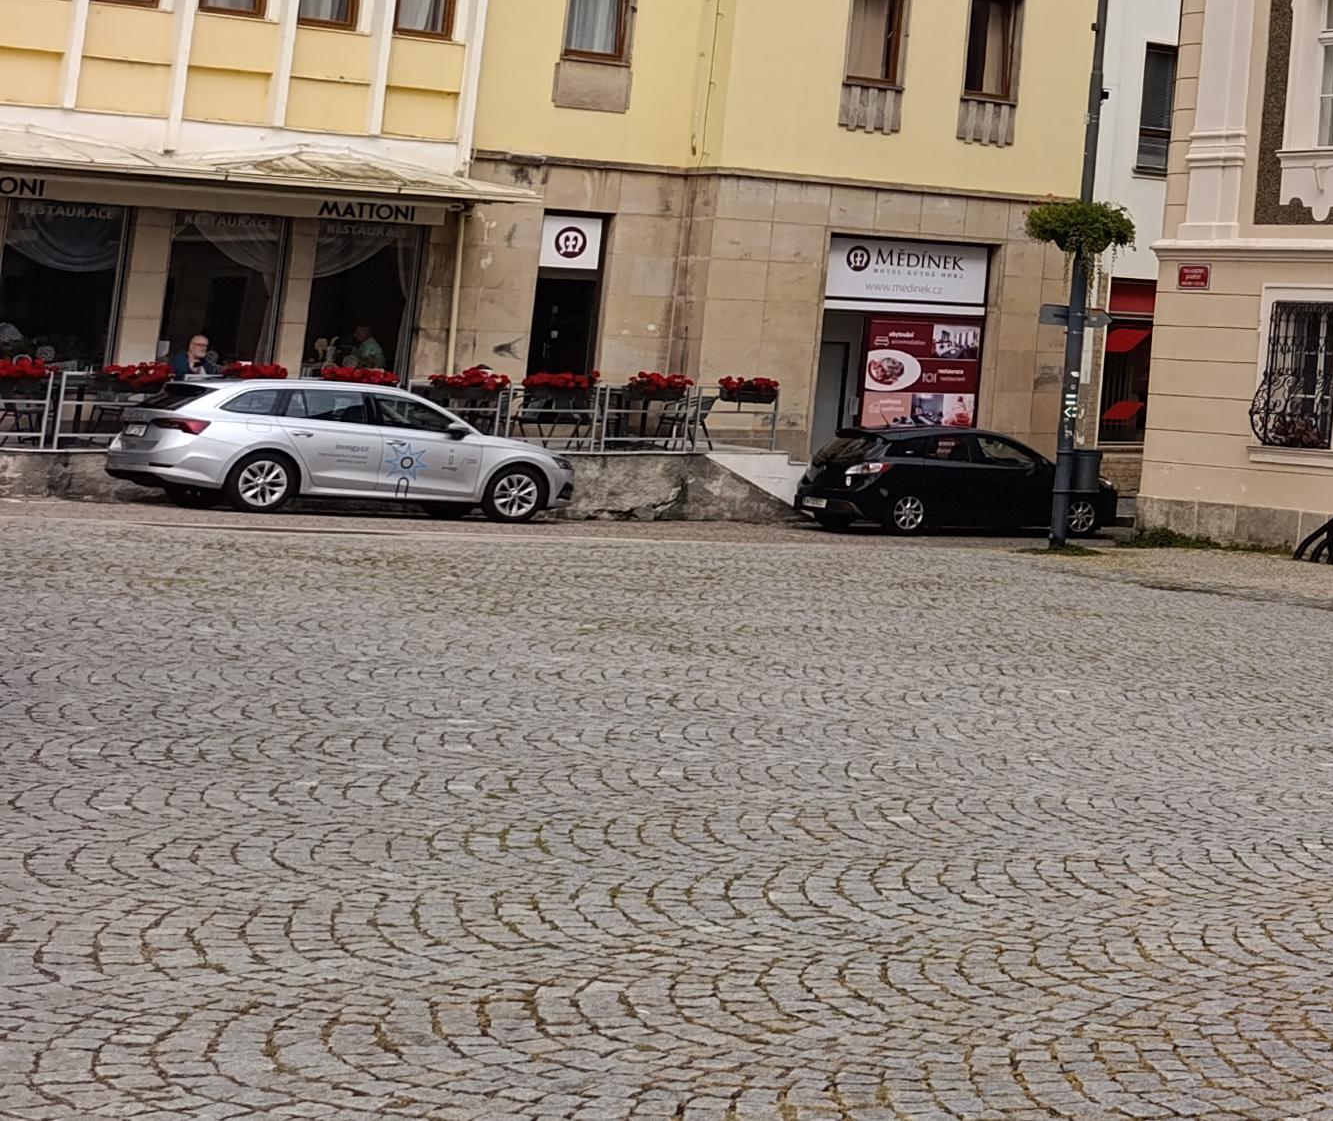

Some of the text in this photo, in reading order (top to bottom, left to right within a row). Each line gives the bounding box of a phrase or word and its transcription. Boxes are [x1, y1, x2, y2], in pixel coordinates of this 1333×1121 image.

[18, 204, 114, 219] RESTAURACE
[318, 200, 416, 221] MATTONI
[875, 248, 965, 271] MĚDÍNEK
[865, 282, 943, 295] www.medinek.cz
